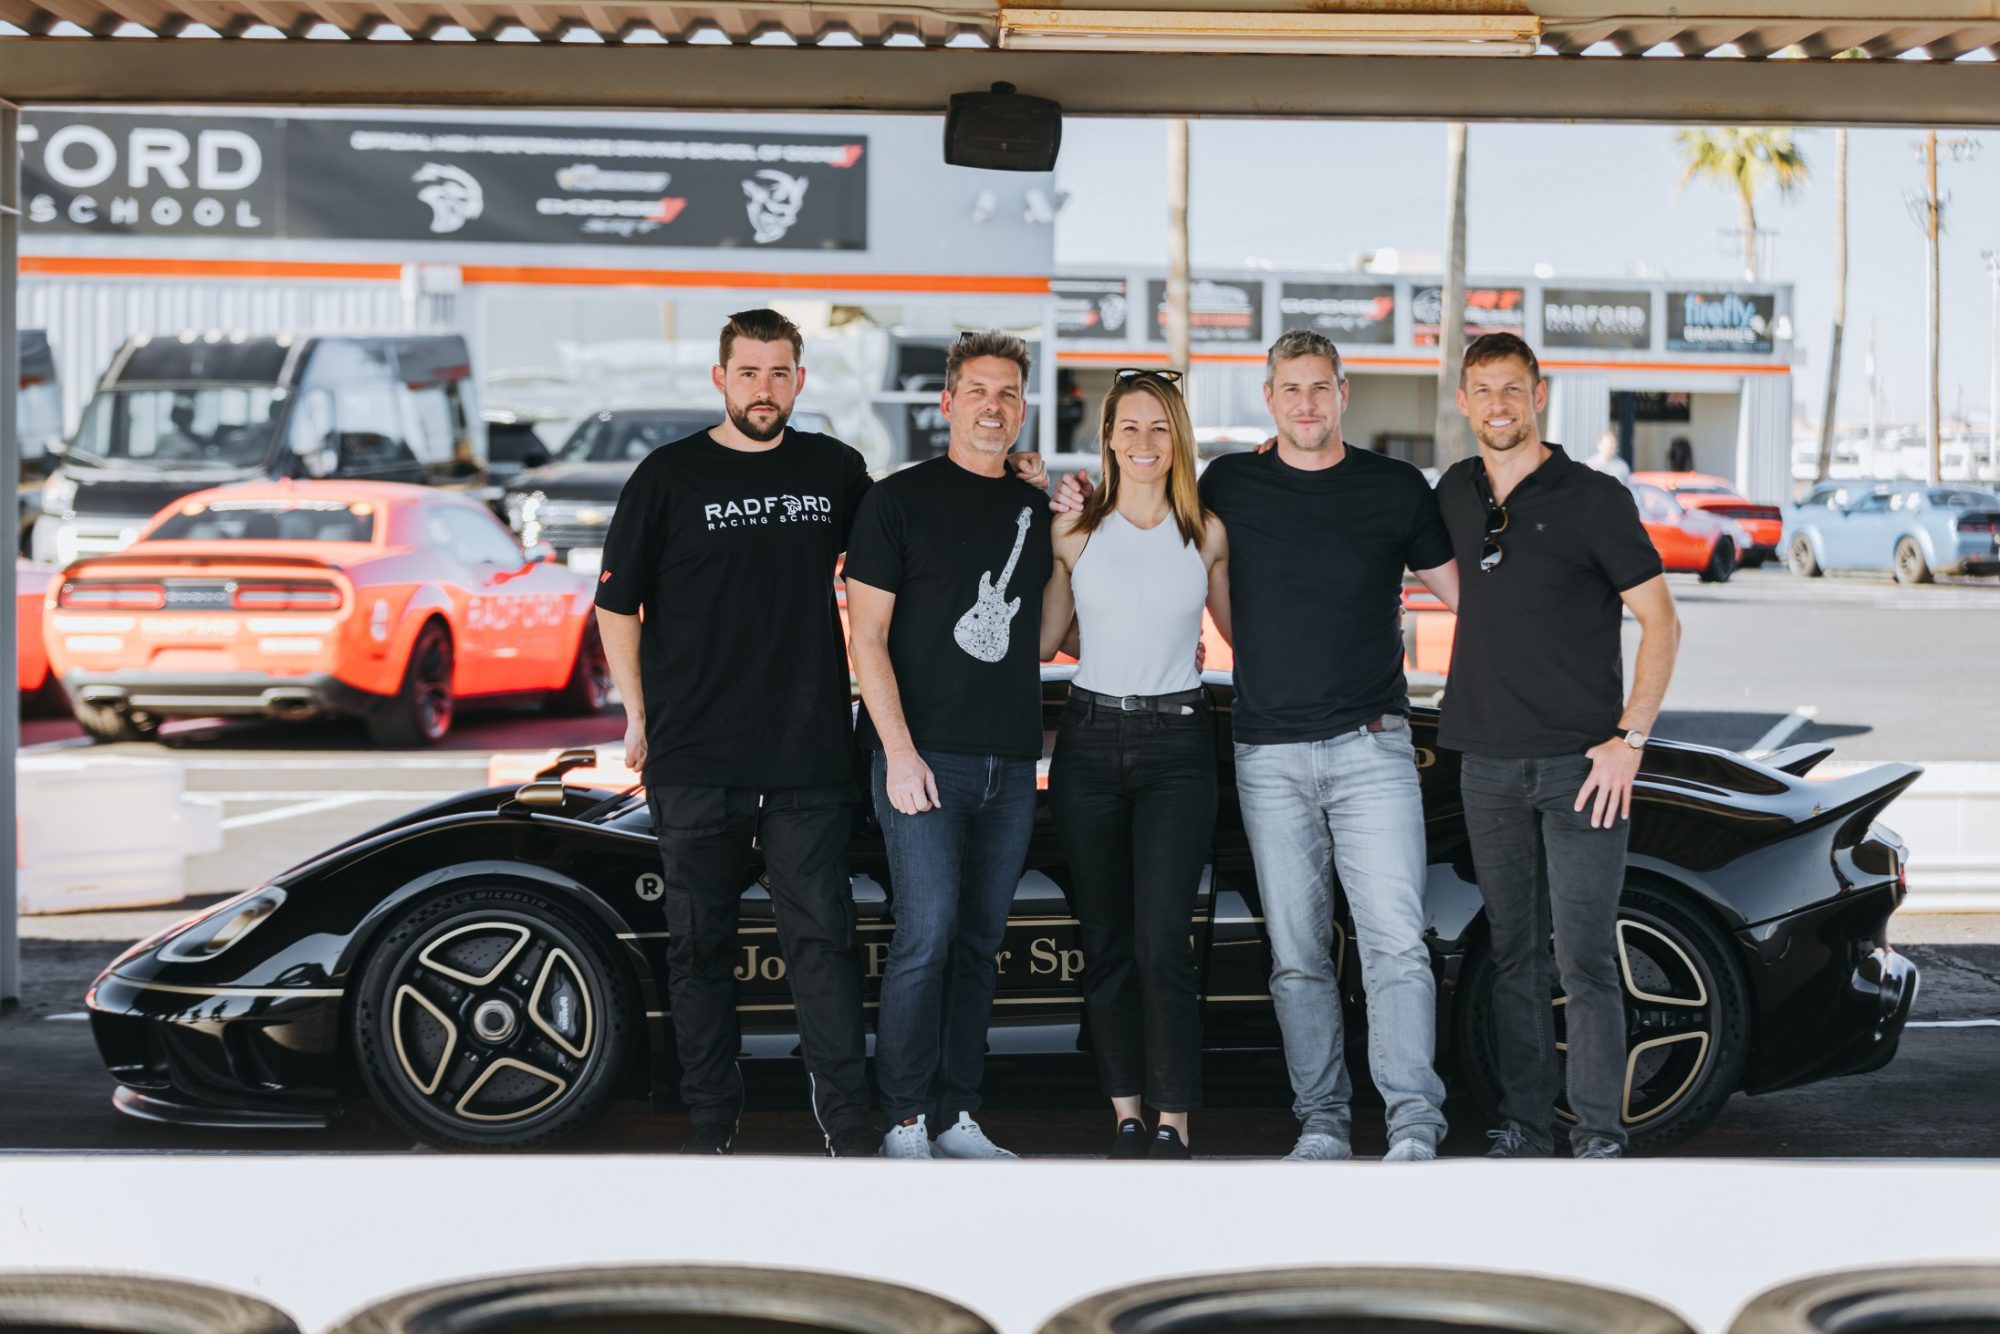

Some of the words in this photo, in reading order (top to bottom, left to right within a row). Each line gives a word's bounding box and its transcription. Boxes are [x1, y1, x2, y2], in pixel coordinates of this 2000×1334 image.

[29, 194, 262, 228] SCHOOL
[1545, 304, 1646, 328] RADFORD
[1684, 291, 1756, 329] firefly
[708, 517, 769, 531] RACING
[780, 514, 832, 524] SCHOOL
[474, 891, 548, 909] MICHELIN
[733, 945, 788, 982] Jo
